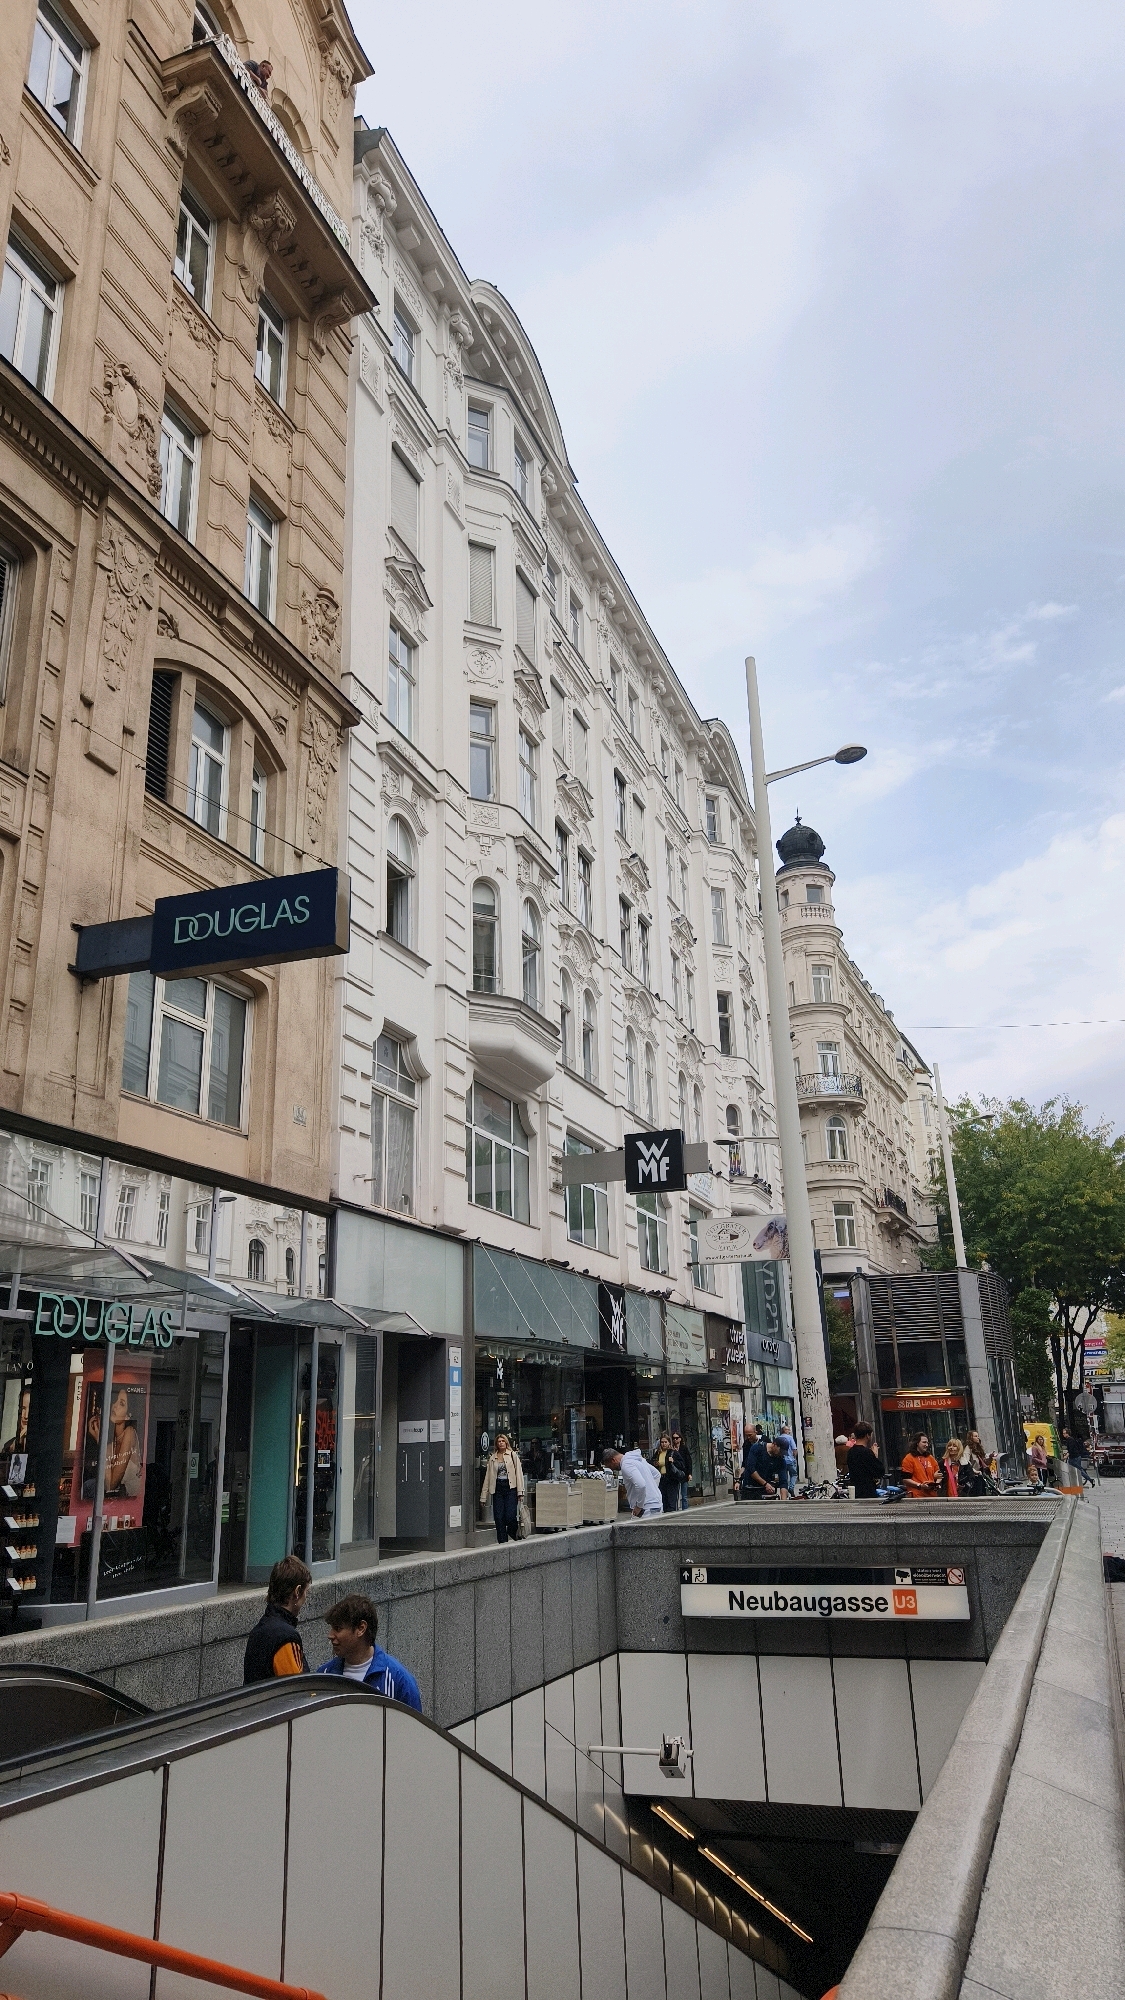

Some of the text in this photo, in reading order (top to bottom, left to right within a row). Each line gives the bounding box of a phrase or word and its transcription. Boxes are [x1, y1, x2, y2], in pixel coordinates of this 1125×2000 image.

[174, 895, 310, 944] DOUGLAS
[635, 1138, 669, 1183] WMF
[35, 1292, 174, 1347] DOUGLAS
[728, 1590, 916, 1616] Neubaugasse U3
